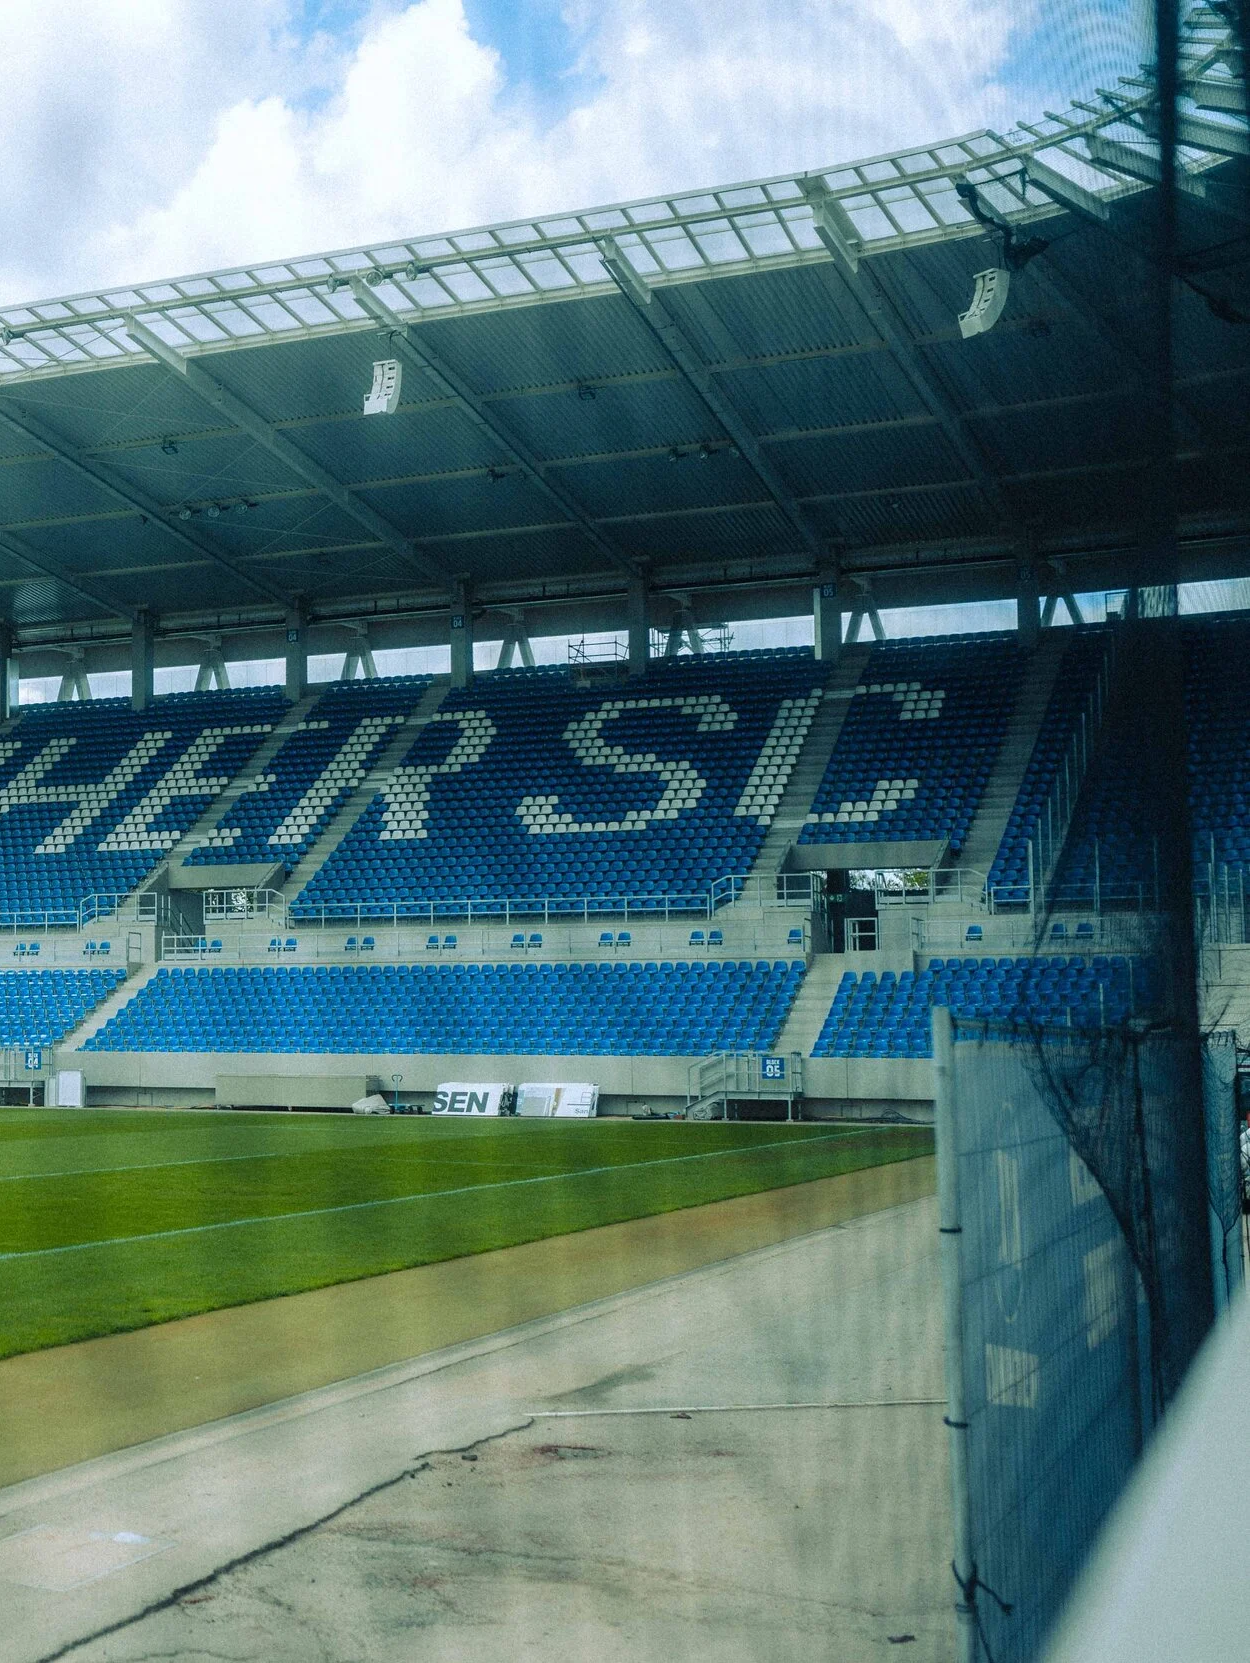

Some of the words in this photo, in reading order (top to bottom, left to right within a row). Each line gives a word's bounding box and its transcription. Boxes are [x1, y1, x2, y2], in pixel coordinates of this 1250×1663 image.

[515, 682, 945, 834] SC
[766, 1064, 780, 1077] 05
[432, 1091, 490, 1113] SEN
